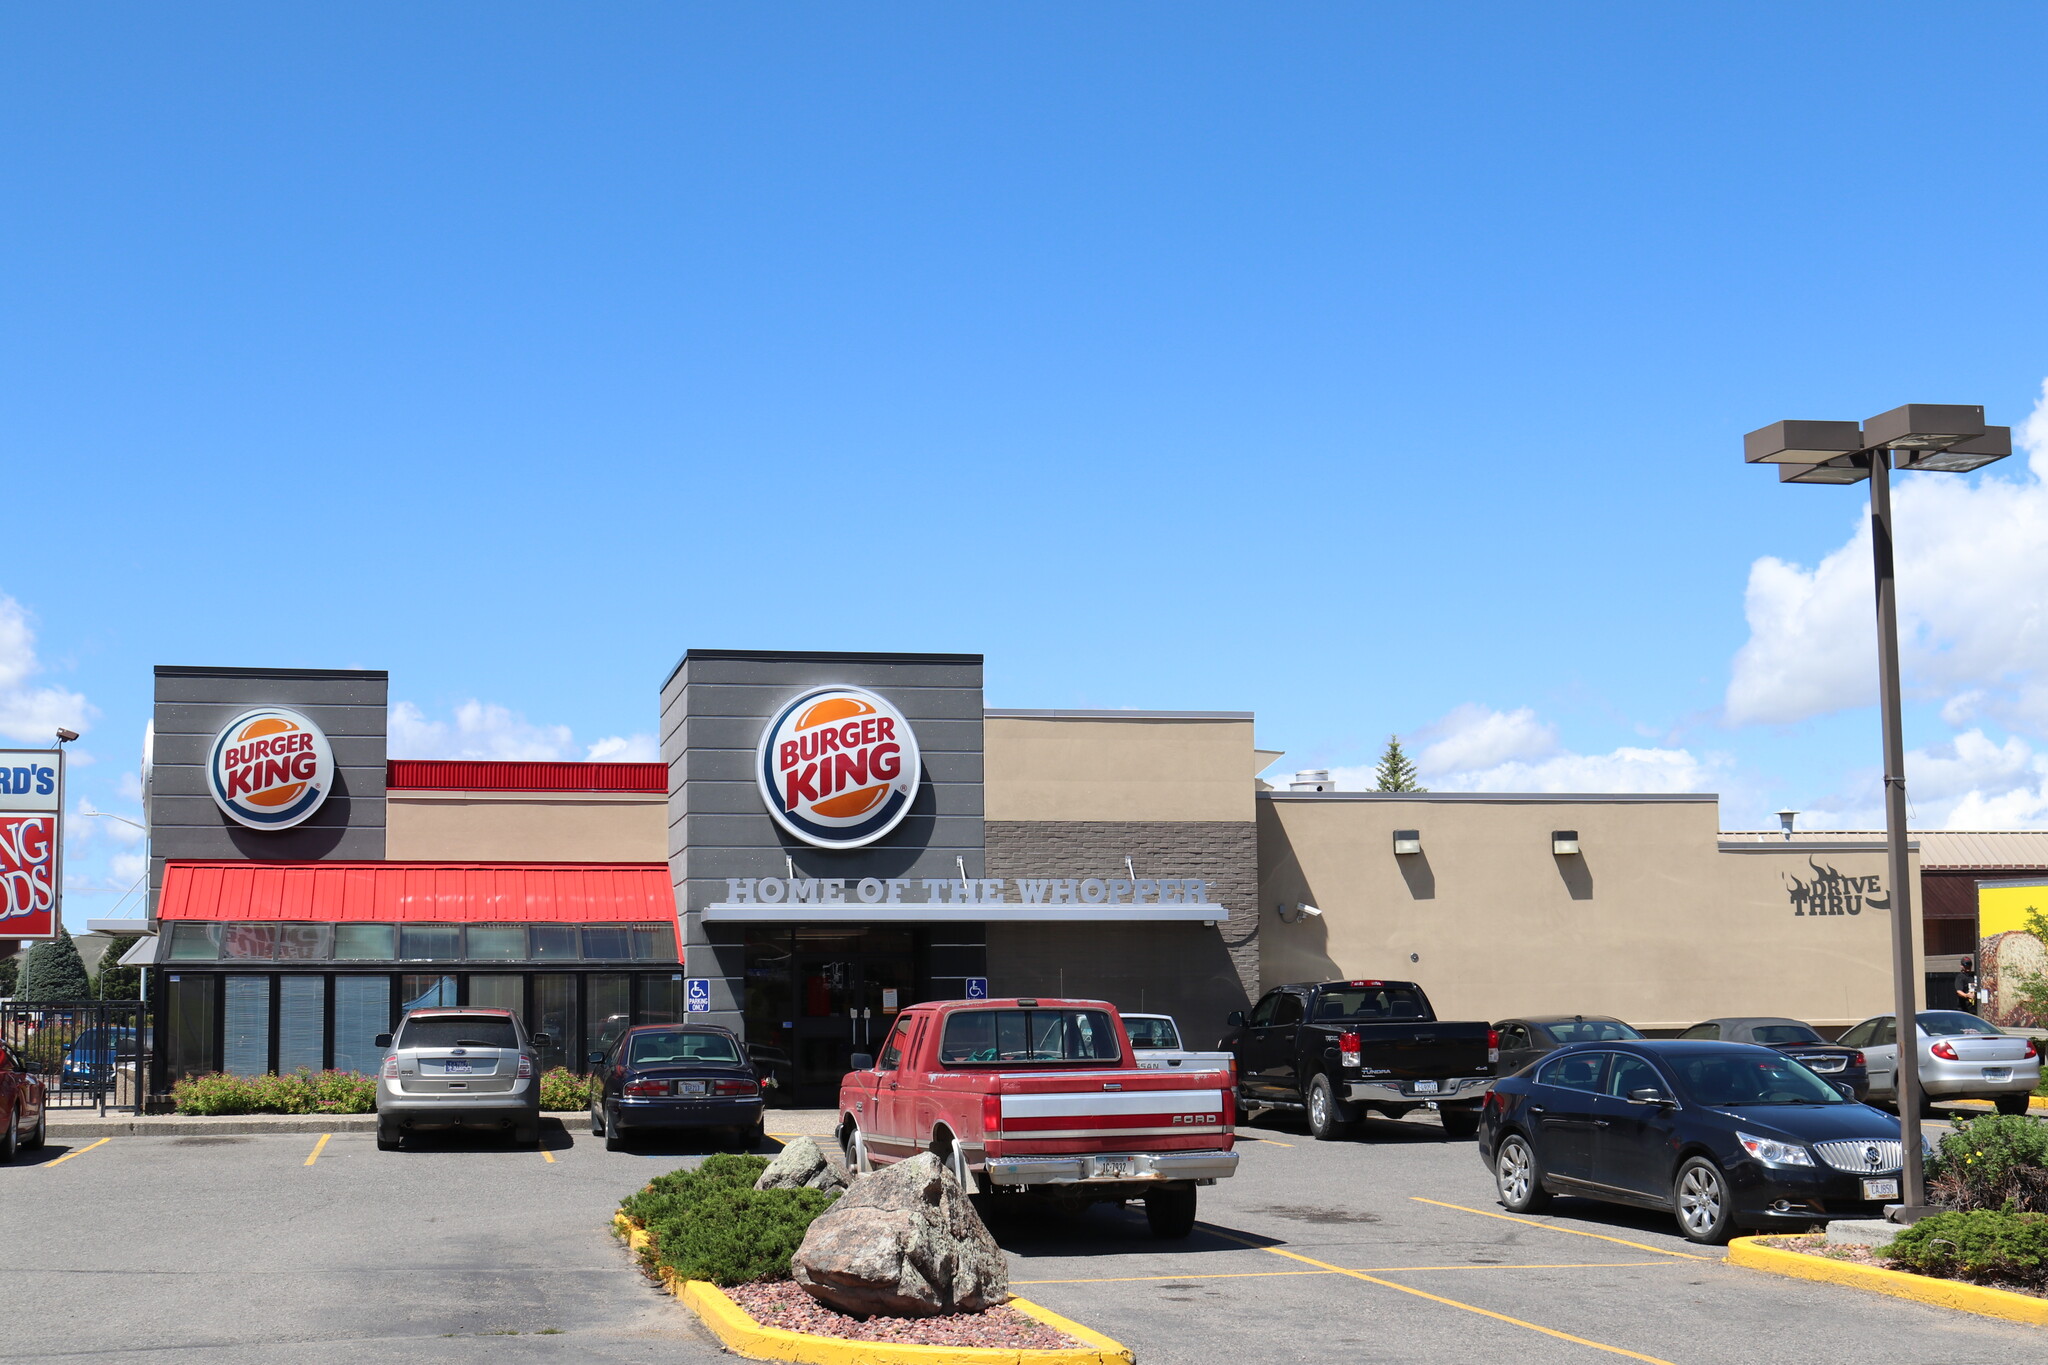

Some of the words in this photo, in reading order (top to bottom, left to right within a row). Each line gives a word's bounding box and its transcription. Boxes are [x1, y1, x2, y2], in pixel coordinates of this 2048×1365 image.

[225, 733, 314, 770] BURGER
[780, 717, 896, 771] BURGER
[0, 764, 54, 795] RD'S
[227, 752, 317, 799] KING
[786, 742, 900, 811] KING
[726, 877, 845, 904] HOME
[856, 877, 911, 904] OF
[922, 878, 1004, 904] THE
[1015, 878, 1208, 904] WHOPPER
[1811, 874, 1881, 898] DRIVE
[1790, 893, 1863, 916] THRU
[1172, 1115, 1217, 1124] FORD
